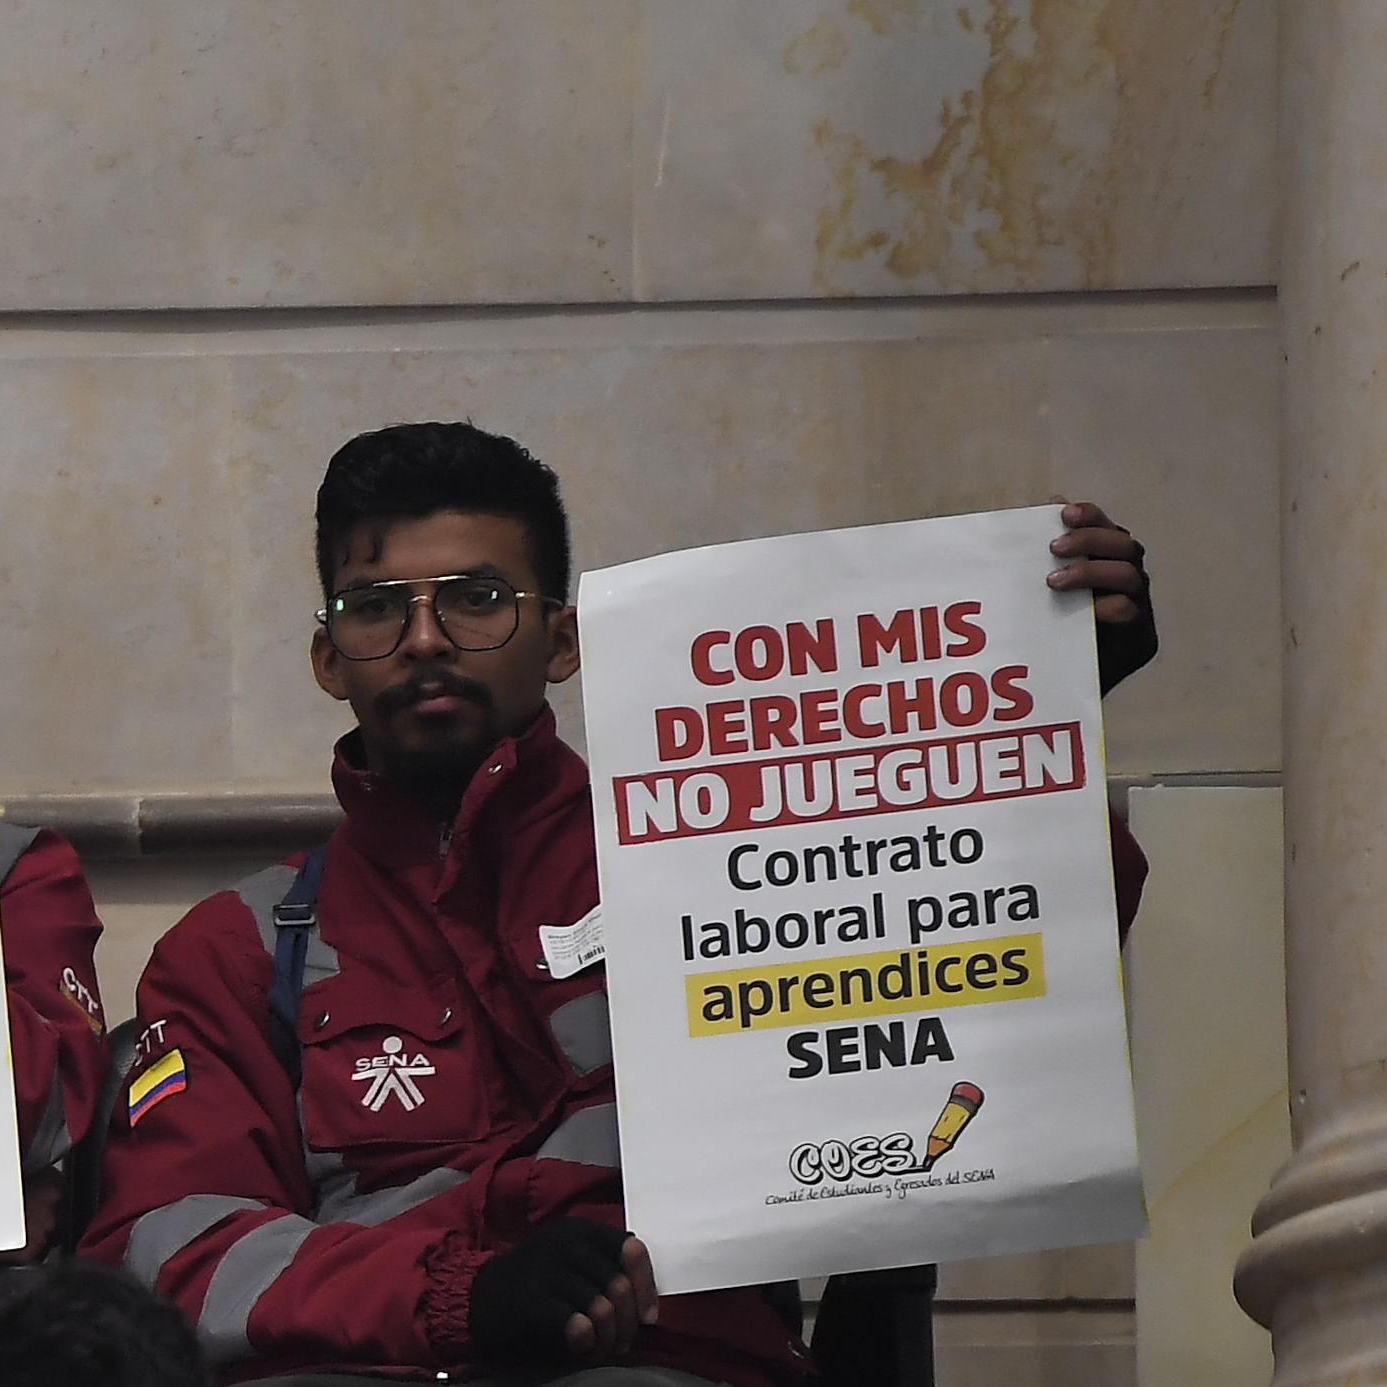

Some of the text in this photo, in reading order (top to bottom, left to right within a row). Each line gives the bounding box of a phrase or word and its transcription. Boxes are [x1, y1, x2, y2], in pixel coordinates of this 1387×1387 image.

[694, 604, 986, 684] CON MIS
[658, 668, 1031, 763] DERECHOS
[626, 731, 1073, 835] NO JUEGUEN
[728, 826, 983, 890] Contrato
[682, 885, 1039, 960] laboral para
[703, 949, 1029, 1028] aprendices
[356, 1053, 430, 1072] SENA
[787, 1017, 954, 1078] SENA
[765, 1190, 804, 1205] Comité
[821, 1183, 882, 1199] Estudiantes
[894, 1179, 942, 1199] Egresados
[789, 1132, 917, 1185] COES
